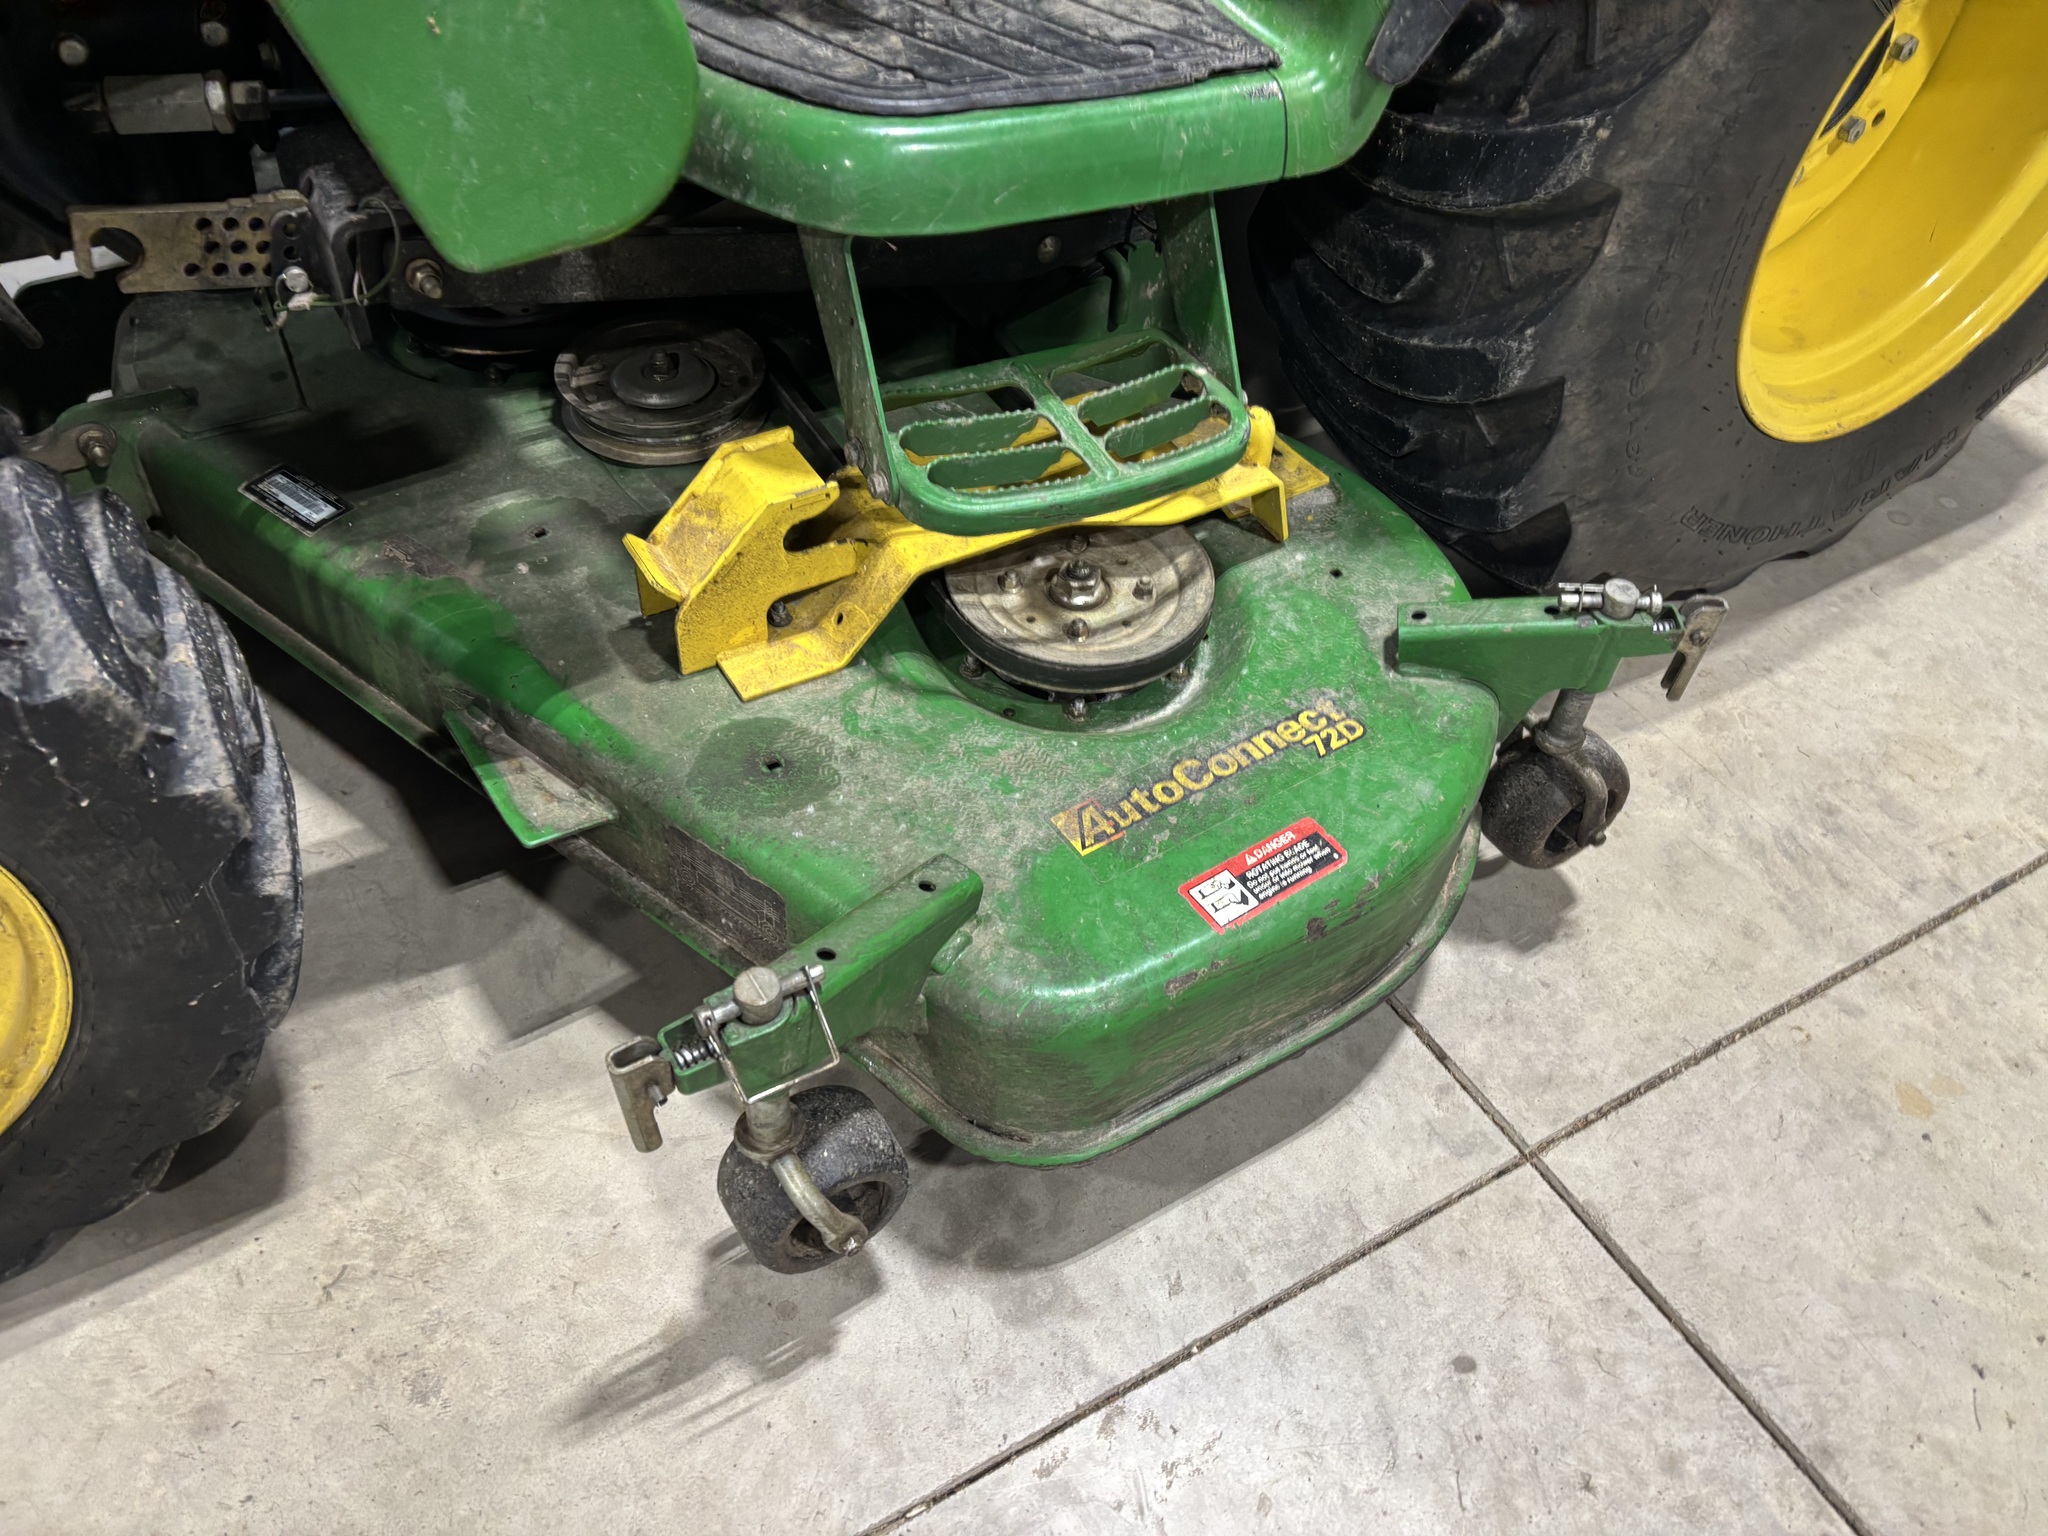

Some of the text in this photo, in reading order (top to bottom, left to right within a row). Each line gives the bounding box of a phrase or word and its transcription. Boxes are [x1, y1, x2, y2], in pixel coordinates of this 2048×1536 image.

[1680, 428, 1958, 544] MARATHONER
[1302, 719, 1365, 757] 72D
[1081, 698, 1347, 847] AutoConnect
[1245, 839, 1310, 880] ROTATING BLADE
[1253, 830, 1296, 859] DANGER
